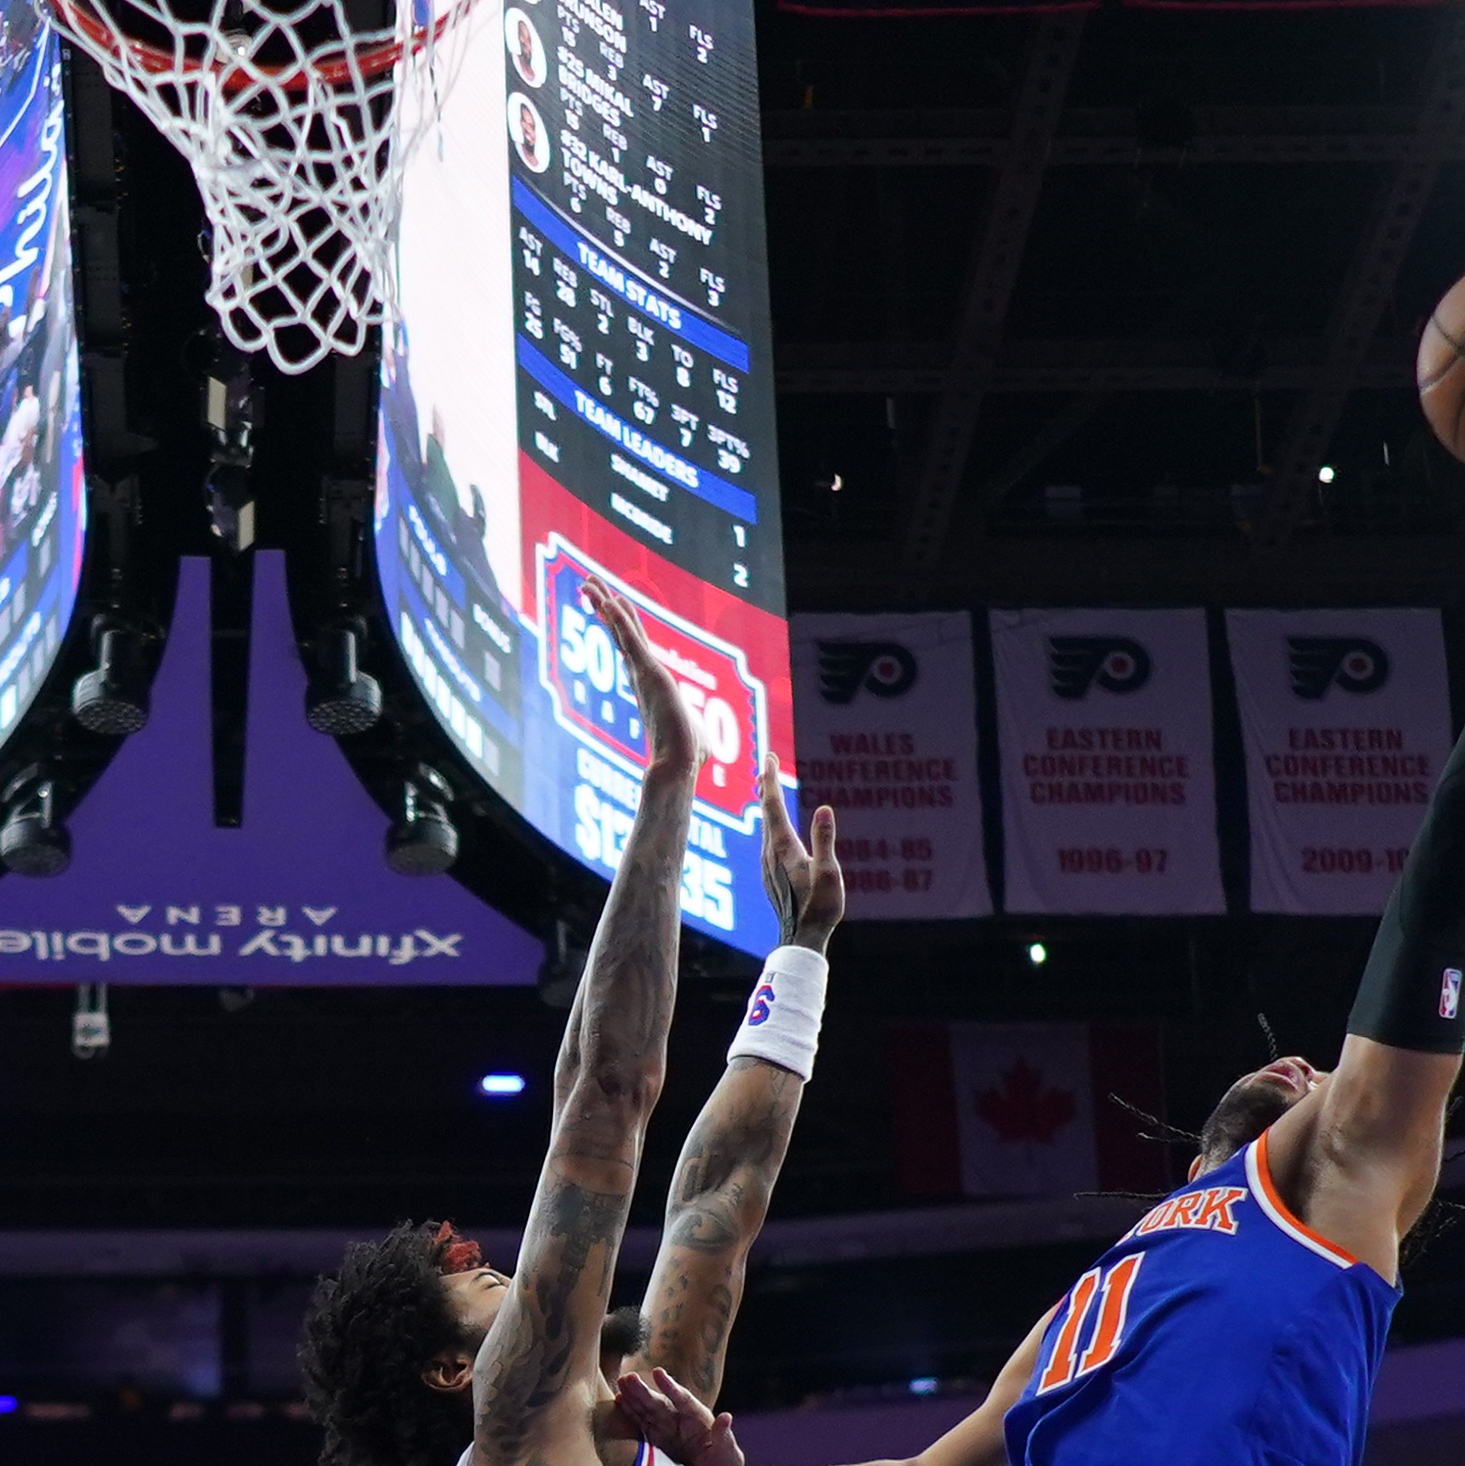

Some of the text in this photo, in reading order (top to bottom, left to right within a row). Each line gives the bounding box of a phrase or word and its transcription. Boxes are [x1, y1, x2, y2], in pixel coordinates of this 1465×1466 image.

[689, 24, 715, 50] FLS
[697, 46, 708, 64] 2
[558, 64, 622, 128] BRIDGES
[586, 68, 635, 118] MIKAL
[643, 74, 671, 100] AST
[693, 103, 719, 131] FLS
[560, 147, 619, 206] TOWNS
[646, 155, 674, 181] AST
[697, 184, 723, 211] FLS
[588, 150, 713, 246] KARL-ANTHONY
[704, 207, 716, 225] 2
[649, 238, 677, 264] AST
[700, 267, 727, 294] FLS
[659, 260, 670, 279] 2
[577, 241, 683, 331] TEAM STATS
[519, 226, 543, 257] AST
[627, 316, 655, 347] BLK
[671, 343, 695, 369] TO
[712, 367, 740, 394] FLS
[595, 352, 614, 376] FT
[574, 388, 700, 489] TEAM LEADERS
[733, 524, 746, 548] 1
[733, 562, 749, 588] 2
[830, 732, 914, 756] WALES
[1046, 727, 1163, 752] EASTERN
[1288, 728, 1404, 752] EASTERN
[795, 757, 958, 783] CONFERENCE
[1021, 754, 1190, 779] CONFERENCE
[1265, 754, 1432, 779] CONFERENCE
[799, 784, 955, 809] CHAMPIONS
[1028, 779, 1188, 804] CHAMPIONS
[1274, 779, 1430, 805] CHAMPIONS
[115, 904, 334, 926] ARENA
[238, 931, 464, 965] xfinity
[1115, 1187, 1249, 1247] ORK
[1036, 1251, 1145, 1396] 11
